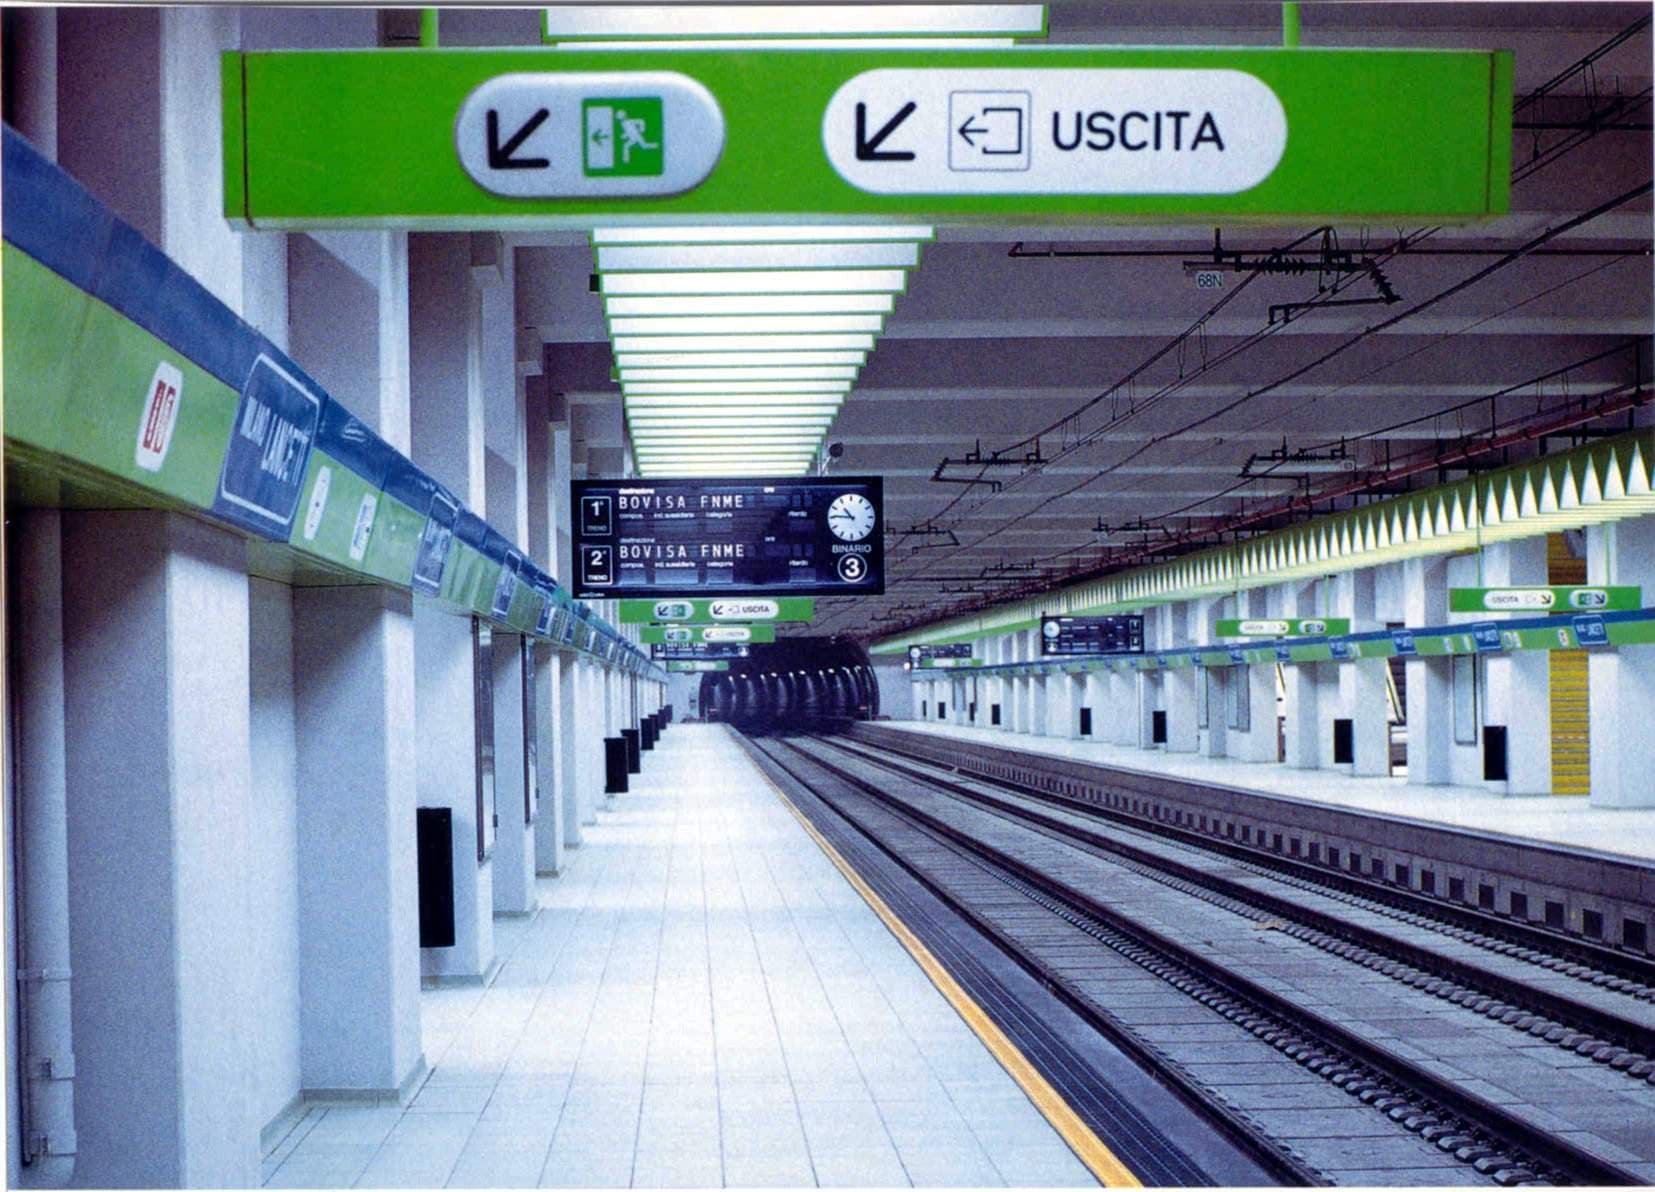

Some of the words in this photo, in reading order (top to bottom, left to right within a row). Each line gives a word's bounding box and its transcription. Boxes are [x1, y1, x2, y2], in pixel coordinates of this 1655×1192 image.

[1051, 111, 1225, 152] USCITA
[1199, 273, 1222, 288] 68N
[619, 496, 686, 509] BOVISA
[700, 494, 744, 509] FNME
[619, 545, 687, 559] BOVISA
[701, 544, 744, 558] FNME
[832, 544, 872, 553] BINARIO
[845, 557, 861, 577] 3
[742, 605, 770, 613] USCITA
